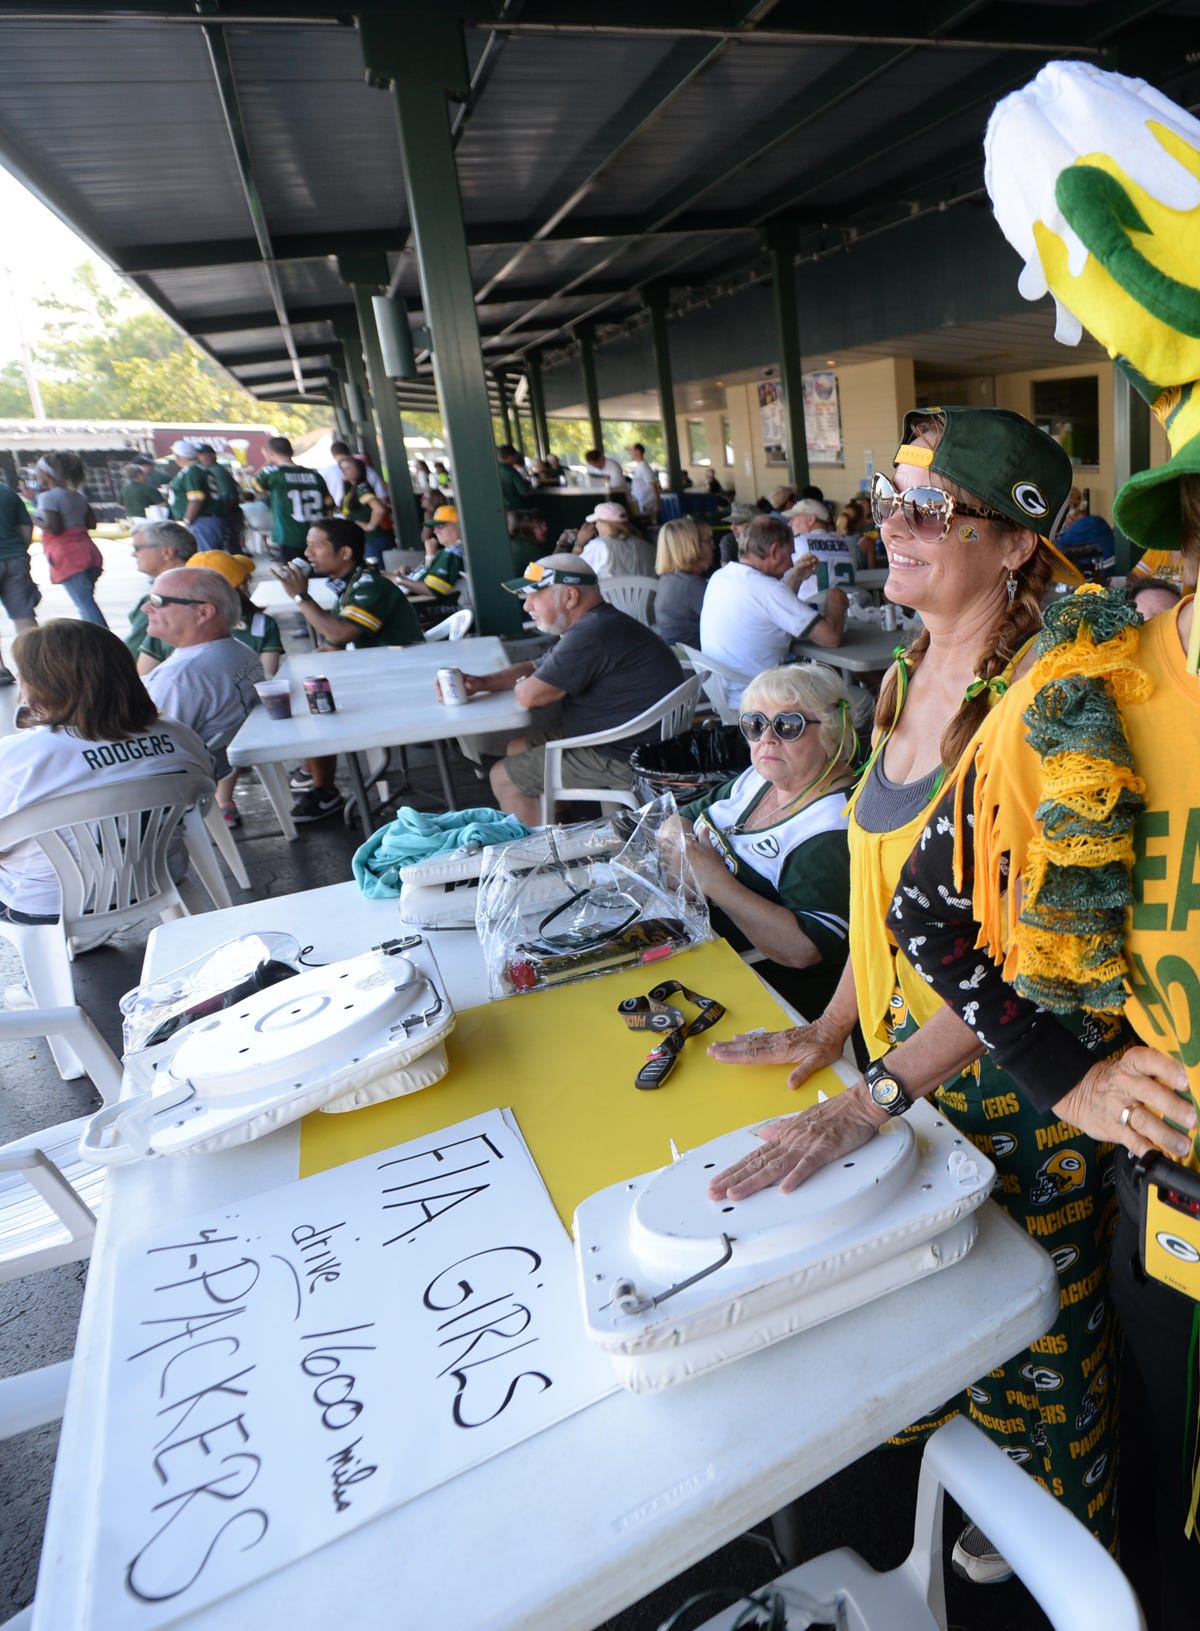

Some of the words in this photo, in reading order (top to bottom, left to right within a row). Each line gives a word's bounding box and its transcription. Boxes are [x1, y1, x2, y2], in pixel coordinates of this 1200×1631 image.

[287, 488, 323, 523] 12
[807, 538, 850, 551] RODGERS
[82, 734, 176, 771] RODGERS
[1025, 1195, 1094, 1237] PACKERS
[290, 1220, 360, 1295] drive
[299, 1321, 377, 1430] 1600
